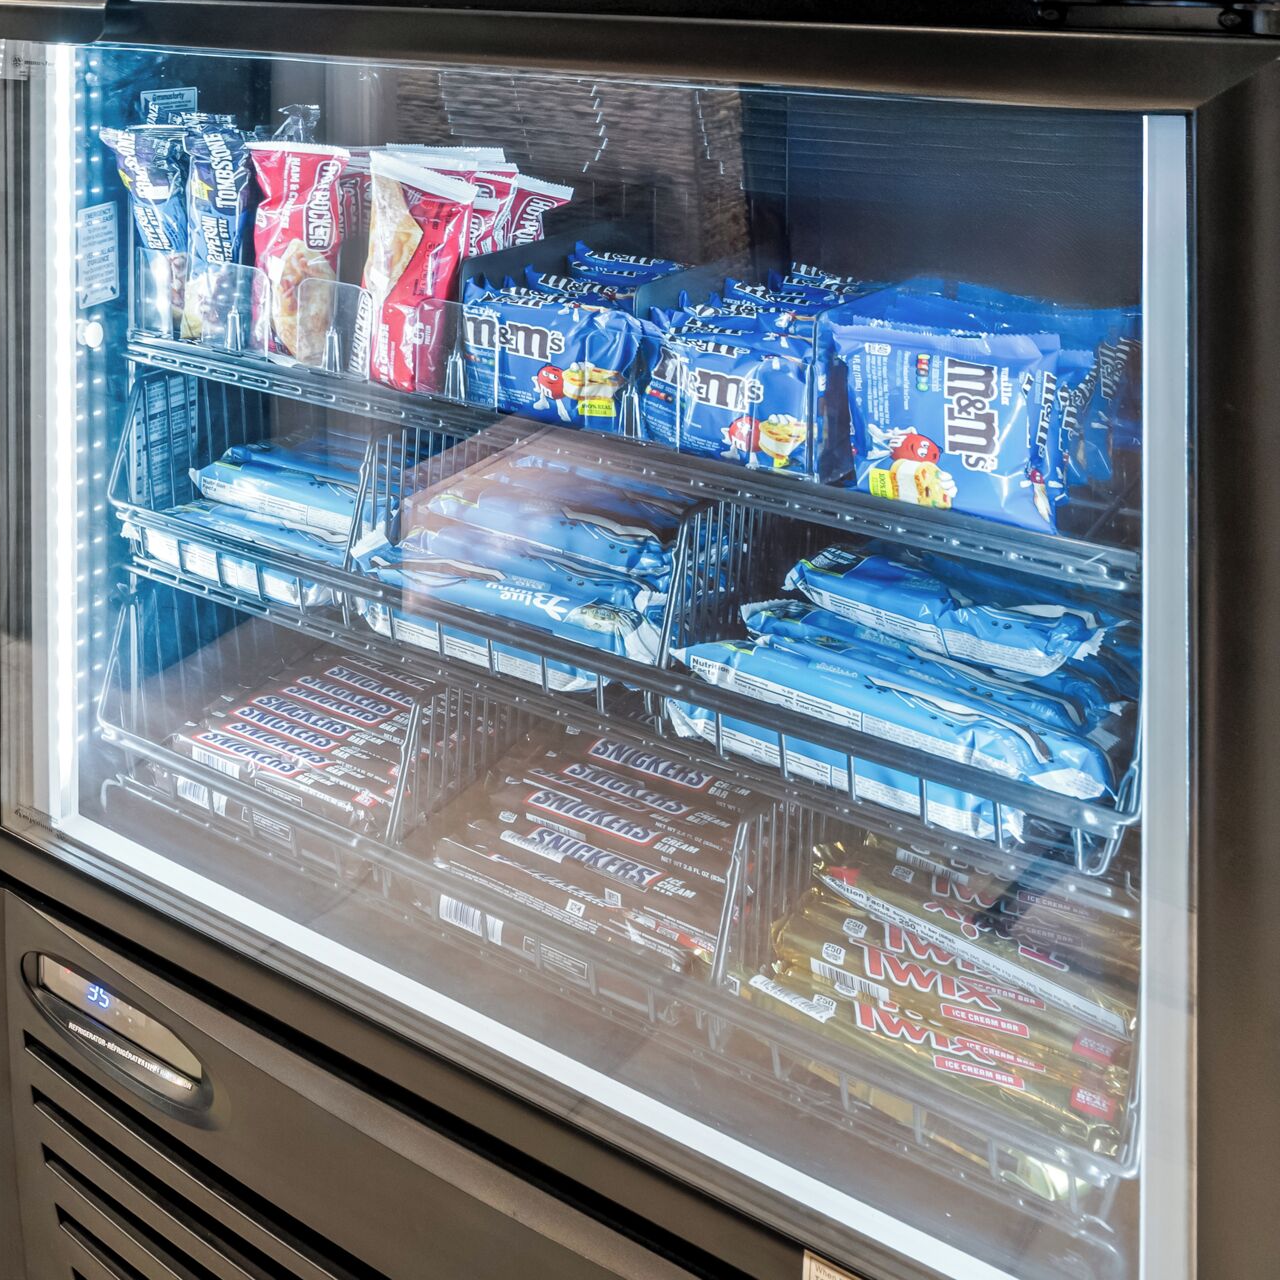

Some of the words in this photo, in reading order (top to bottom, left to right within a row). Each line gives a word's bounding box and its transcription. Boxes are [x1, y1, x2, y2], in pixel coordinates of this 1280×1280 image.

[290, 157, 301, 183] HAM
[239, 706, 333, 749] SNICKERS
[258, 695, 352, 736] SNICKERS
[592, 738, 709, 789] SNICKERS
[531, 790, 659, 844] SNICKERS
[532, 827, 659, 886] SNICKERS
[653, 842, 677, 855] BAR
[661, 836, 701, 855] CREAM
[657, 881, 697, 900] CREAM
[866, 893, 890, 911] Facts
[824, 943, 842, 955] 250
[87, 983, 110, 1009] 35
[817, 995, 835, 1008] 250
[1017, 994, 1036, 1005] BAR
[951, 1009, 966, 1019] ICE
[968, 1012, 1000, 1028] CREAM
[1000, 1022, 1019, 1033] BAR
[981, 1045, 1014, 1061] CREAM
[944, 1061, 960, 1071] ICE
[961, 1064, 994, 1079] CREAM
[995, 1073, 1014, 1085] BAR
